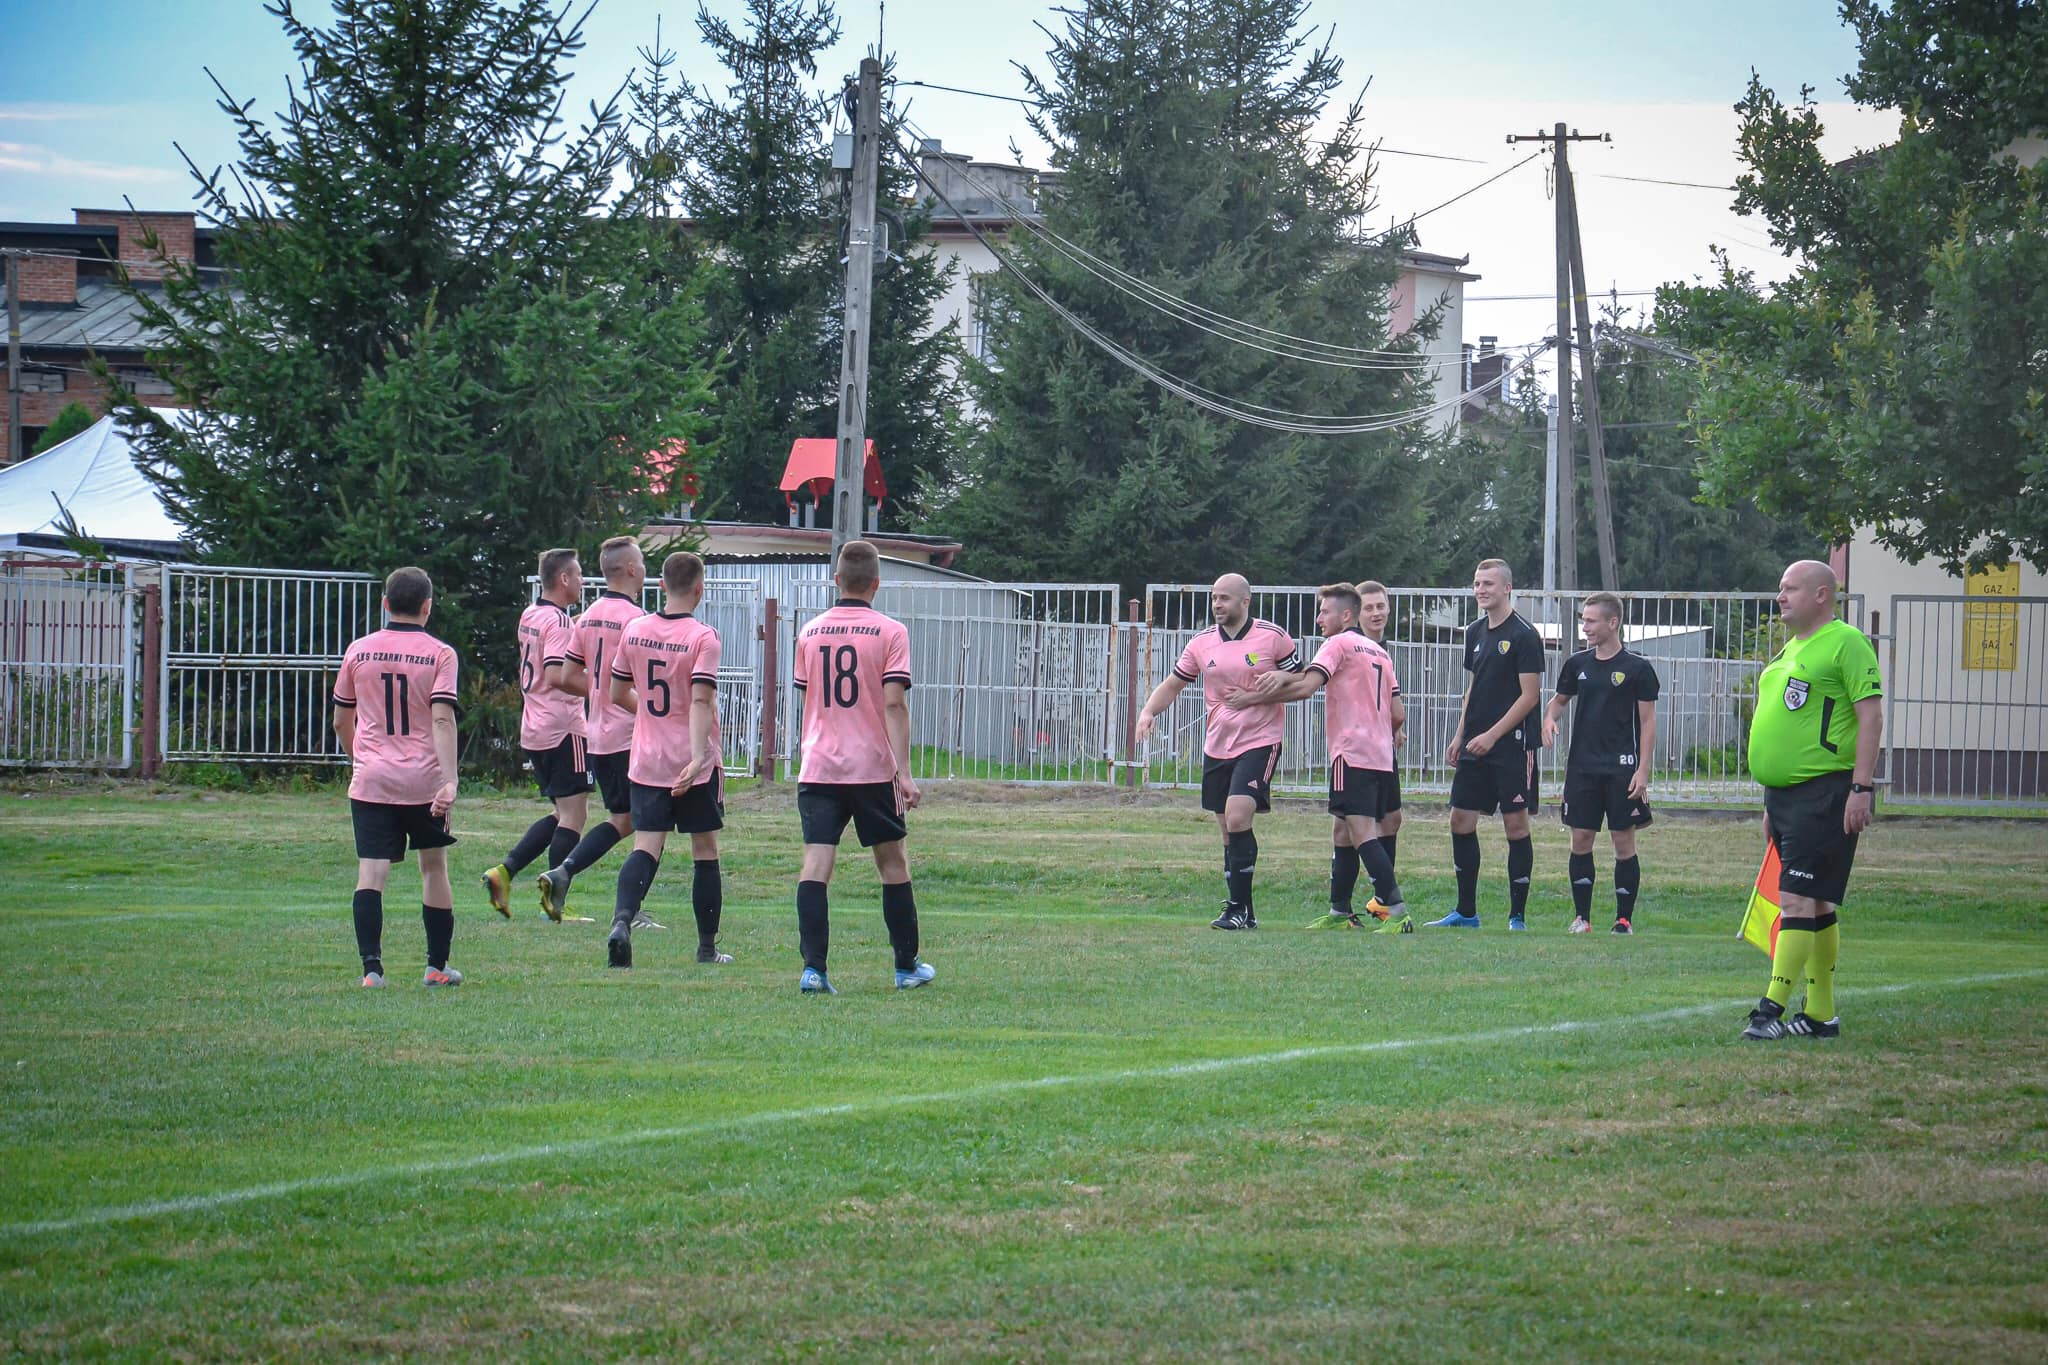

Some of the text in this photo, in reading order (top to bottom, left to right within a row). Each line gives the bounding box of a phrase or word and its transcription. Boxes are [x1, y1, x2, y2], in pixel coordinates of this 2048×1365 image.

[1984, 584, 2002, 593] GAZ
[820, 626, 847, 634] CZARNI
[372, 652, 402, 663] CZARNI
[819, 644, 859, 708] 18
[647, 658, 670, 717] 5
[1371, 661, 1383, 712] 7
[380, 672, 410, 736] 11
[1515, 729, 1521, 739] 8
[1619, 754, 1634, 764] 20
